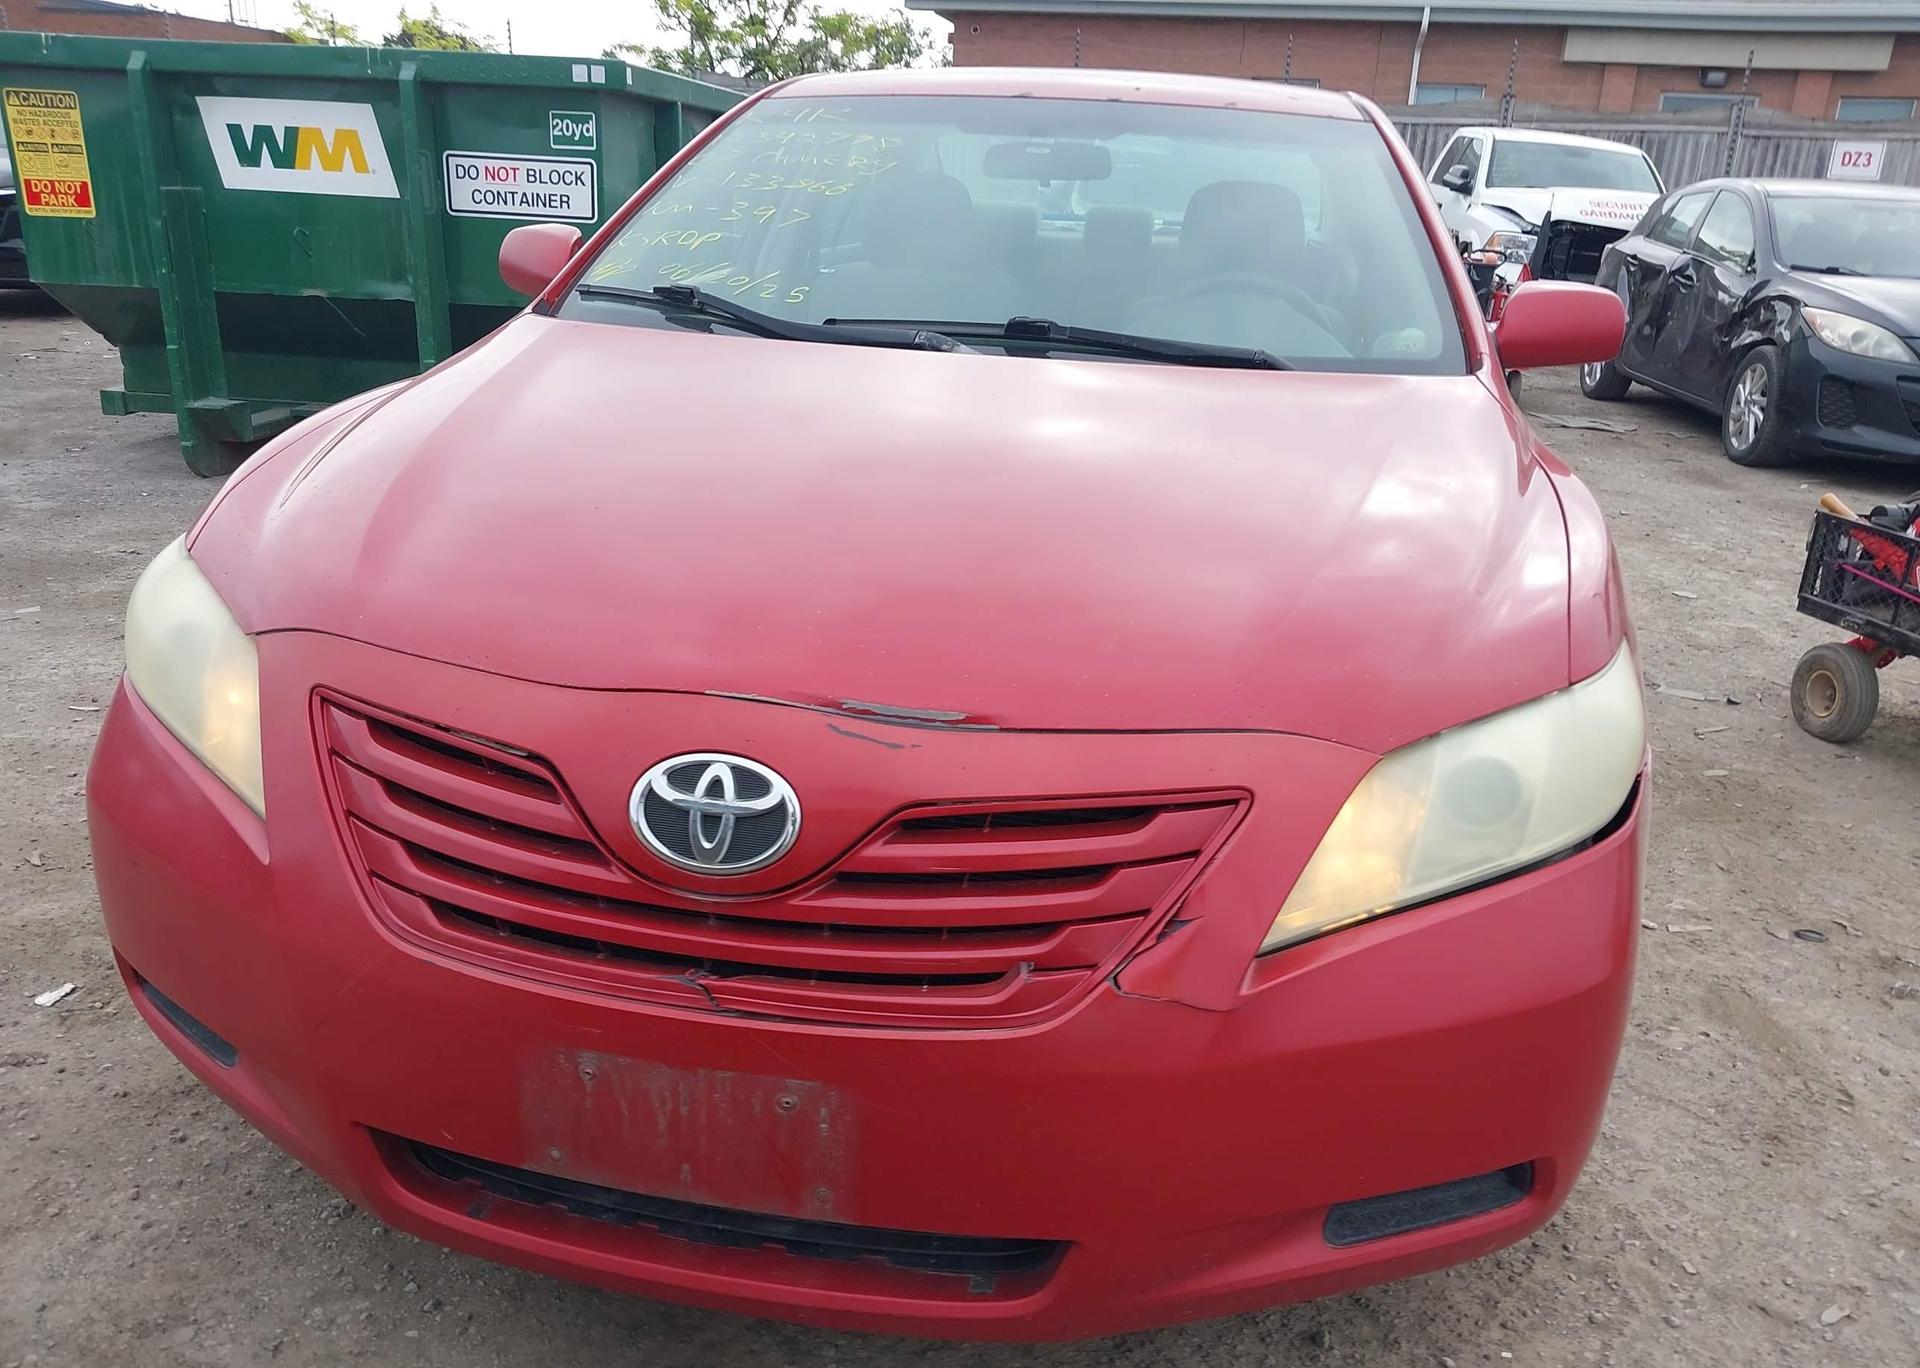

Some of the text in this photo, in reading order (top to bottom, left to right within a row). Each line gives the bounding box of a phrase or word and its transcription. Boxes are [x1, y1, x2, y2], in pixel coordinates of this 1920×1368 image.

[19, 91, 75, 109] CAUTION
[16, 109, 72, 120] NO HAZARDOUS
[12, 118, 80, 129] WASTES ACCEPTED
[552, 118, 593, 141] 20yd
[225, 122, 371, 175] WM
[1840, 151, 1873, 168] DZ3
[455, 162, 586, 187] DO NOT BLOCK
[31, 180, 83, 195] DO NOT
[40, 194, 79, 208] PARK
[470, 189, 572, 210] CONTAINER
